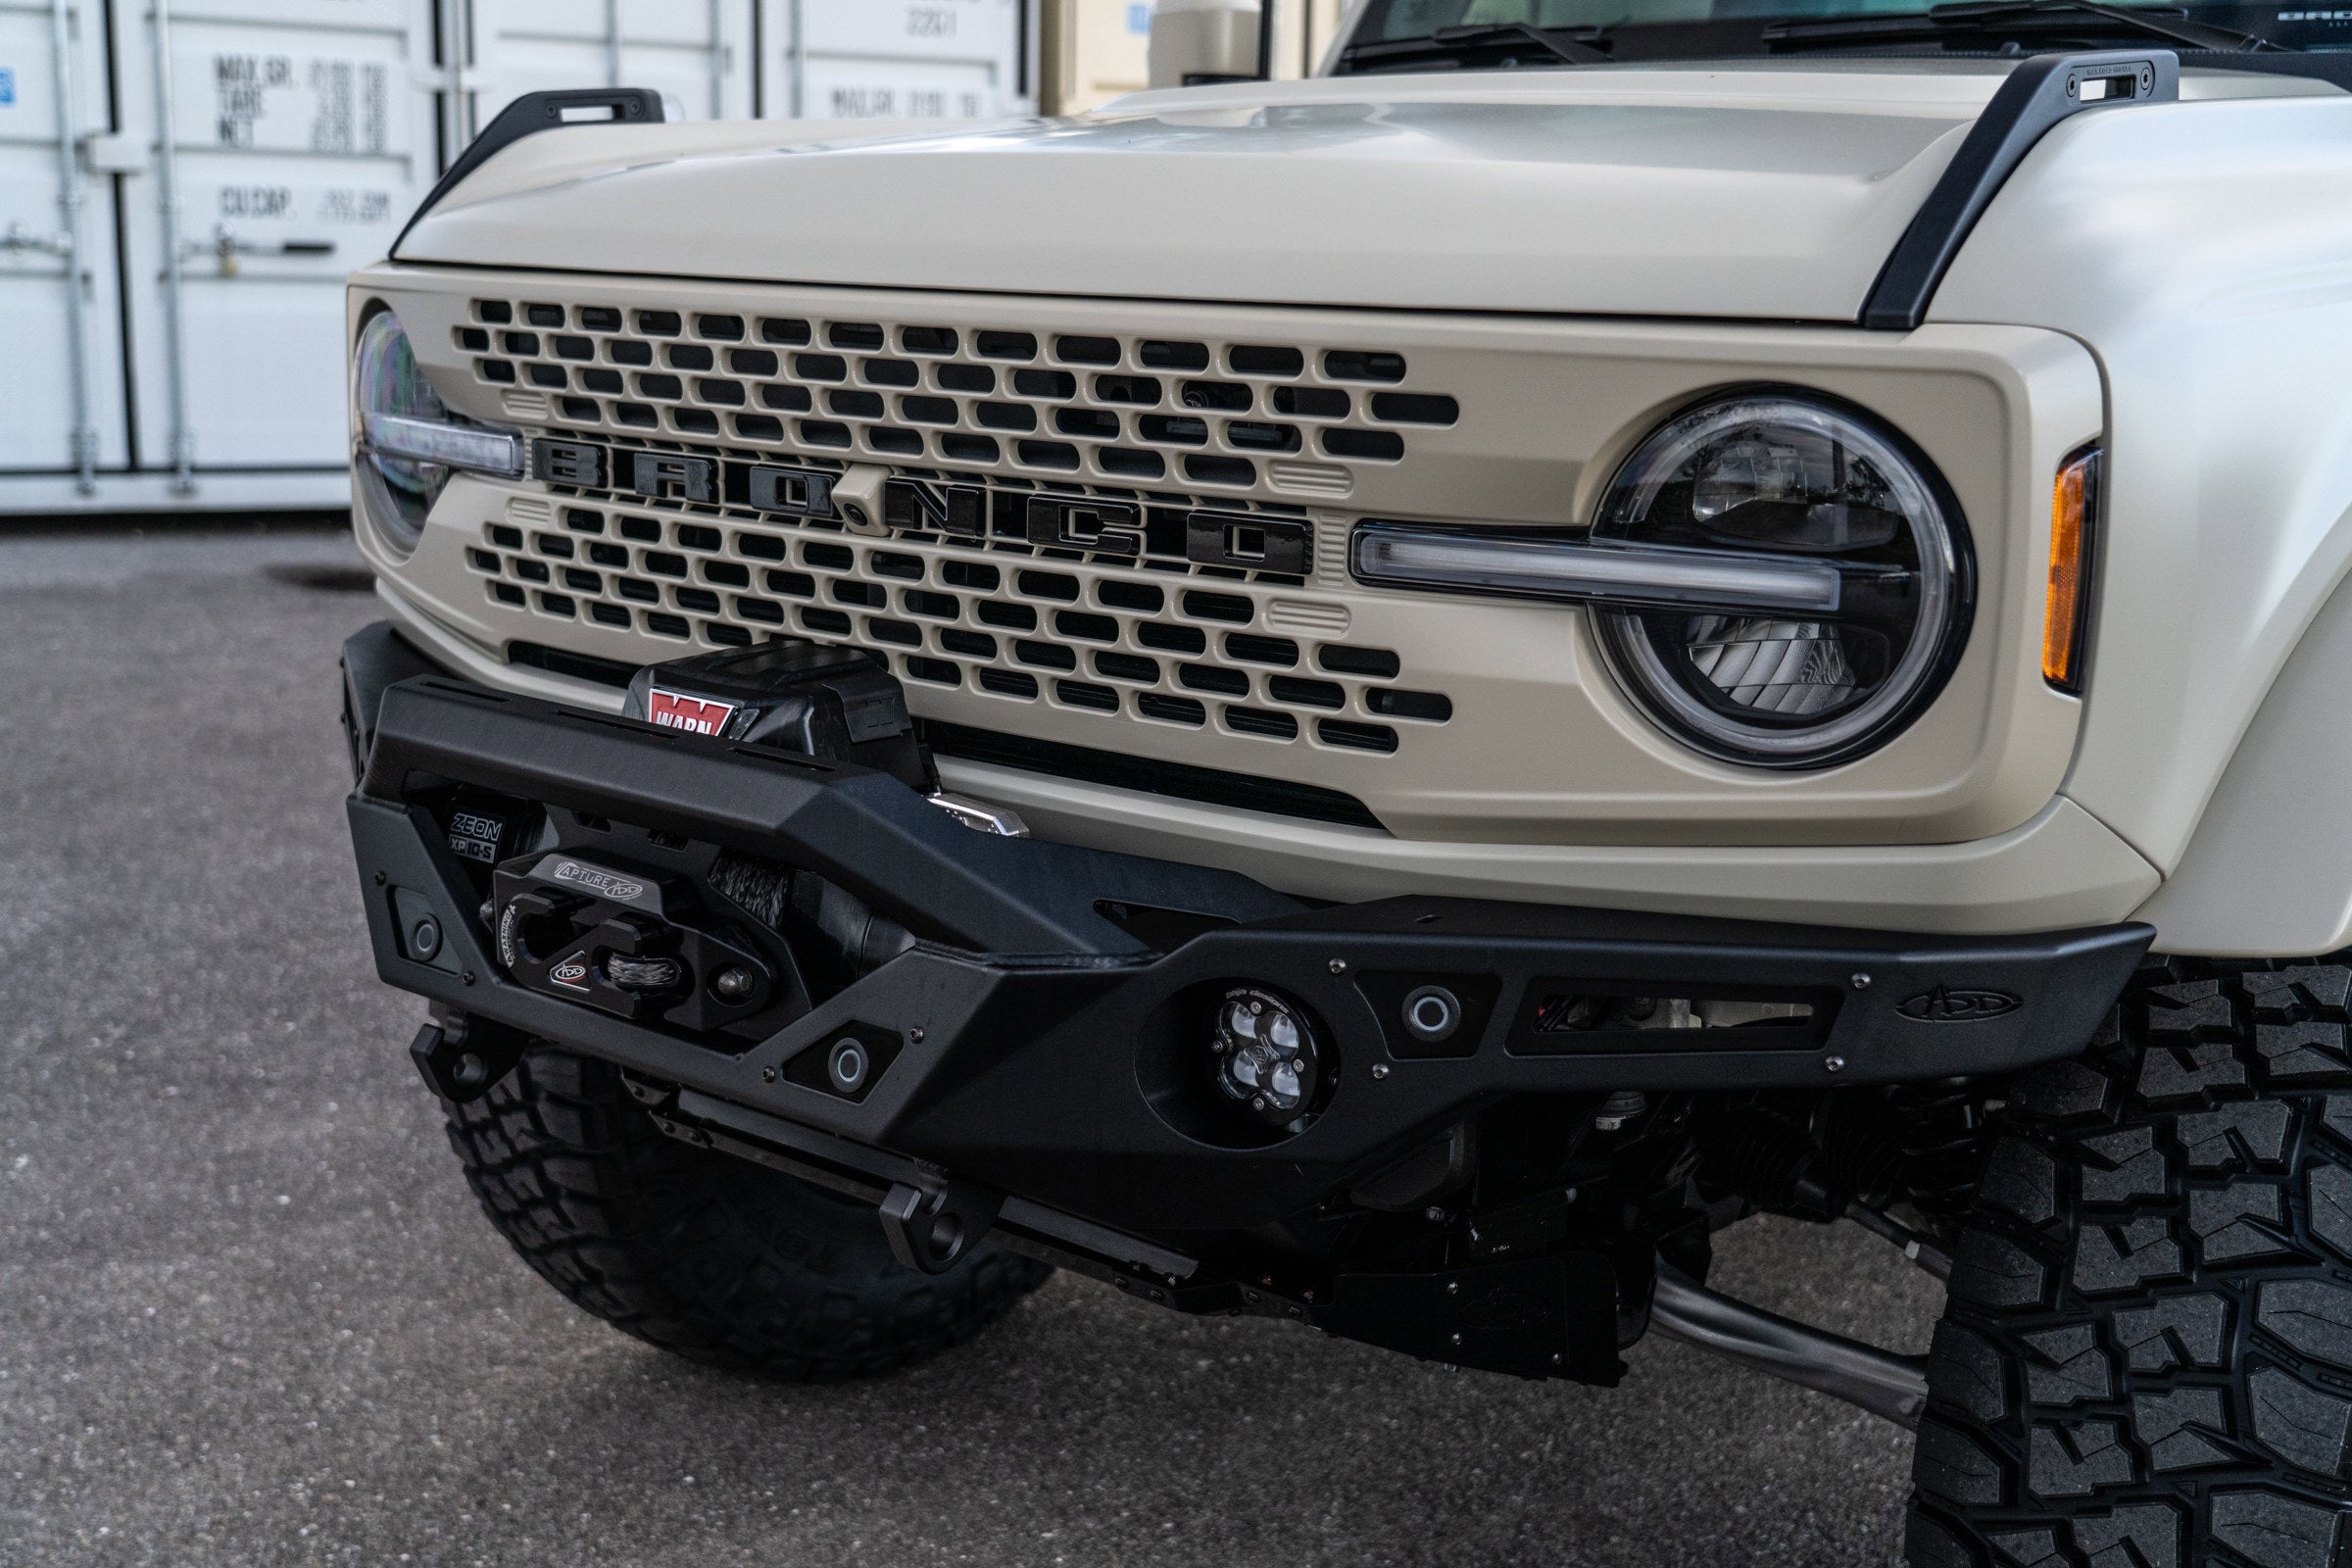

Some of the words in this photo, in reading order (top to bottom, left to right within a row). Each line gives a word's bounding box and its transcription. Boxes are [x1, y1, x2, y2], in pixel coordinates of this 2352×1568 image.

[531, 437, 1314, 576] BRONCO
[656, 711, 712, 735] WARN
[451, 812, 503, 842] ZEON
[501, 911, 512, 956] WARNING
